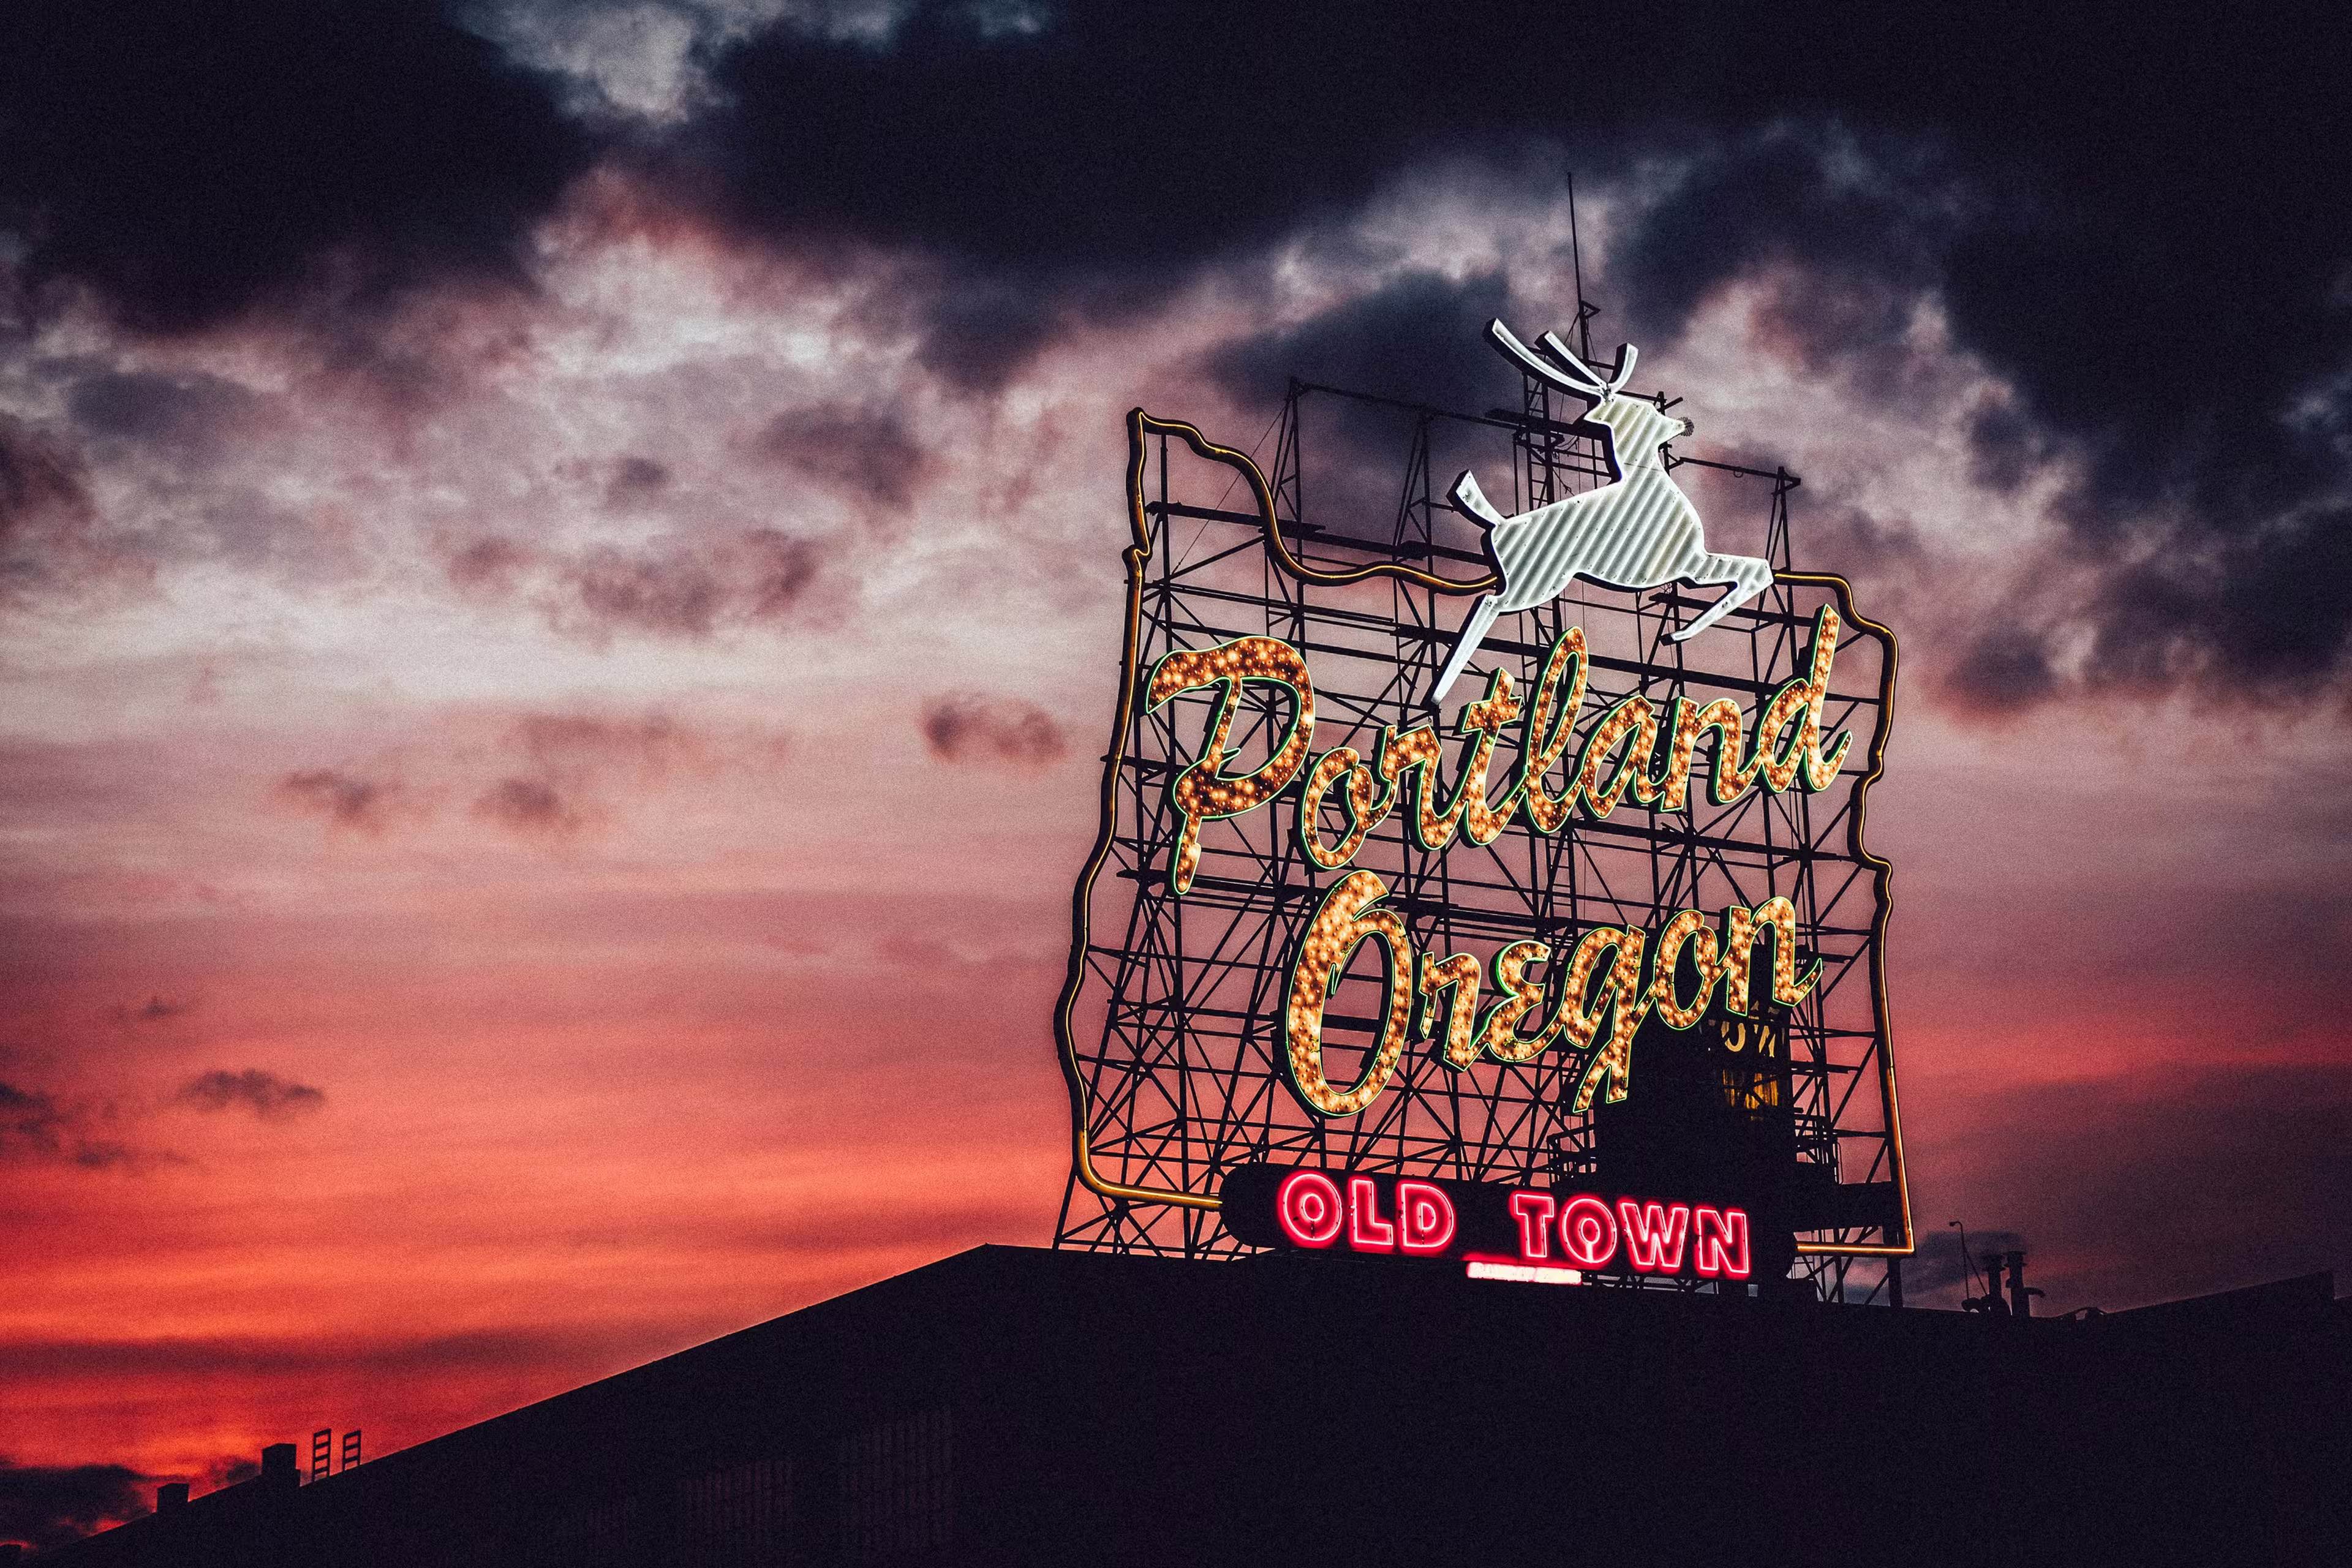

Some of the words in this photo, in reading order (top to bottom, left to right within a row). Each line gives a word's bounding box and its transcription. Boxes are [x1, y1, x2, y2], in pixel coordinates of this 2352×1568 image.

[1145, 603, 1853, 896] Portland
[1286, 869, 1823, 1117] Oregon
[1278, 1172, 1457, 1247] OLD
[1512, 1192, 1751, 1278] TOWN
